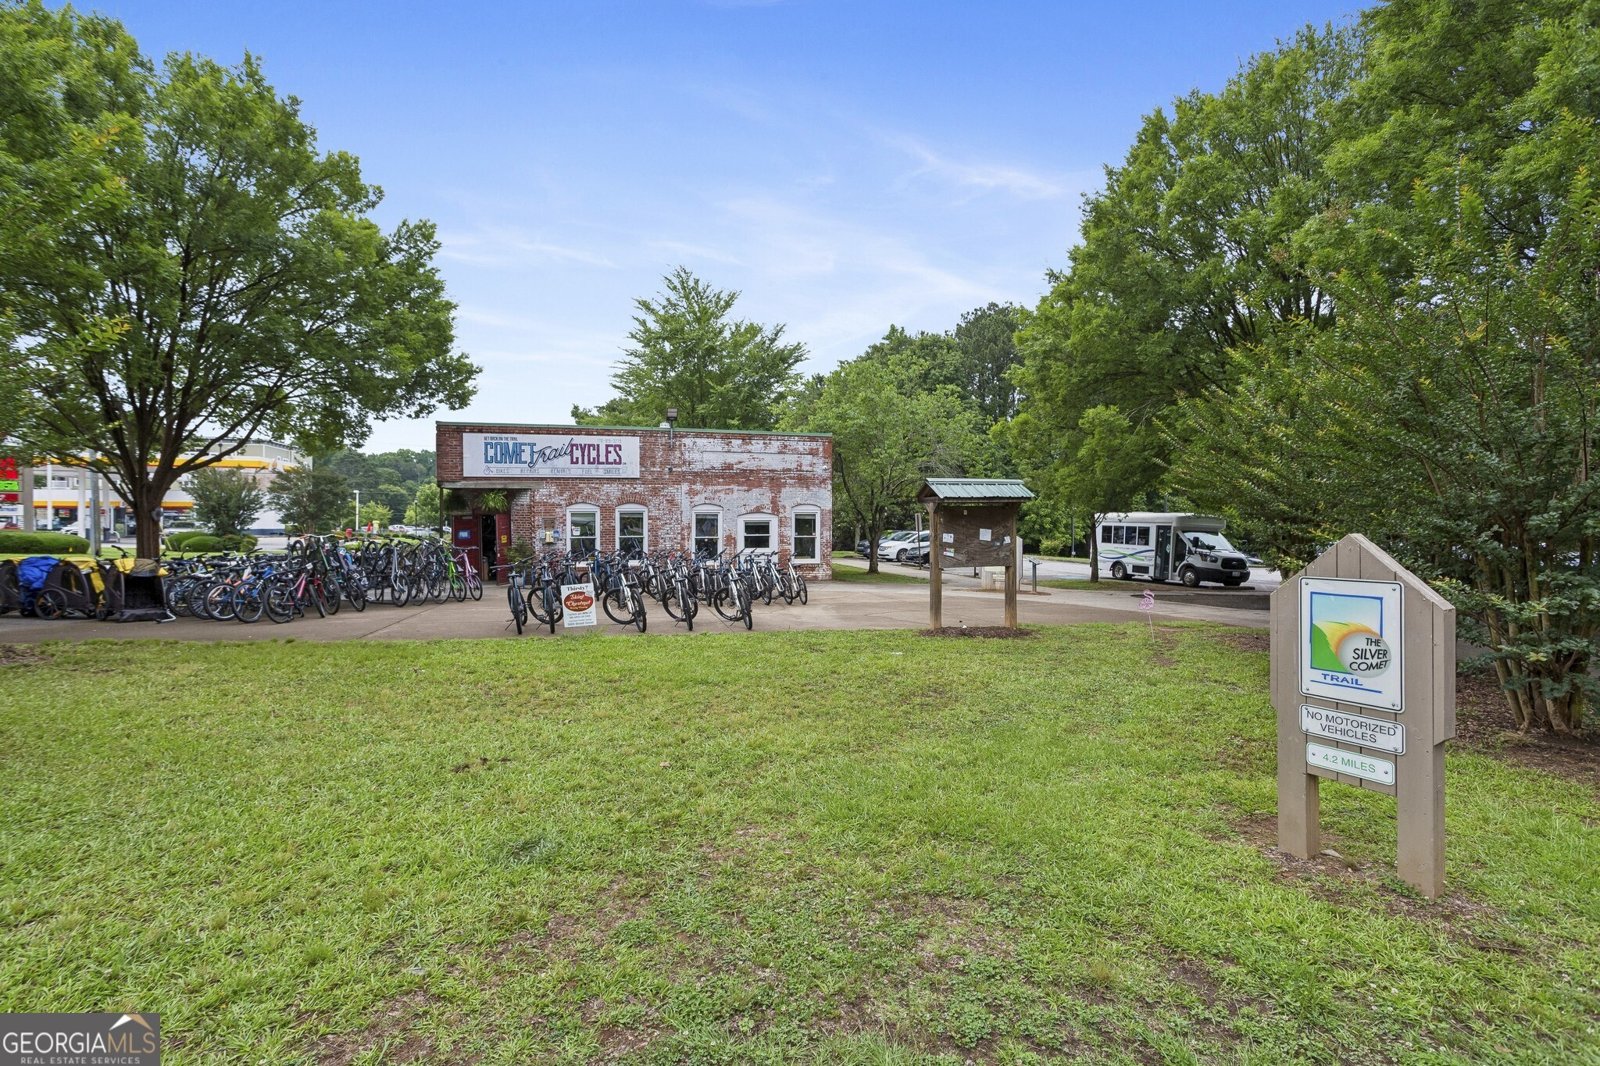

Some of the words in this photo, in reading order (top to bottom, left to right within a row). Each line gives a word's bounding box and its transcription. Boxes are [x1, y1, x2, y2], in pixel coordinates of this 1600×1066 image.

[484, 442, 536, 464] COMET
[528, 438, 573, 468] Trail
[570, 444, 622, 465] CYCLES
[1365, 637, 1382, 647] THE
[1352, 648, 1388, 660] SILVER
[1349, 660, 1388, 672] COMET
[1321, 673, 1363, 686] TRAIL
[1306, 710, 1322, 722] NO
[1325, 714, 1396, 737] MOTORIZED
[1320, 722, 1377, 744] VEHICLES
[1322, 752, 1338, 764] 4.2
[1341, 757, 1376, 774] MILES
